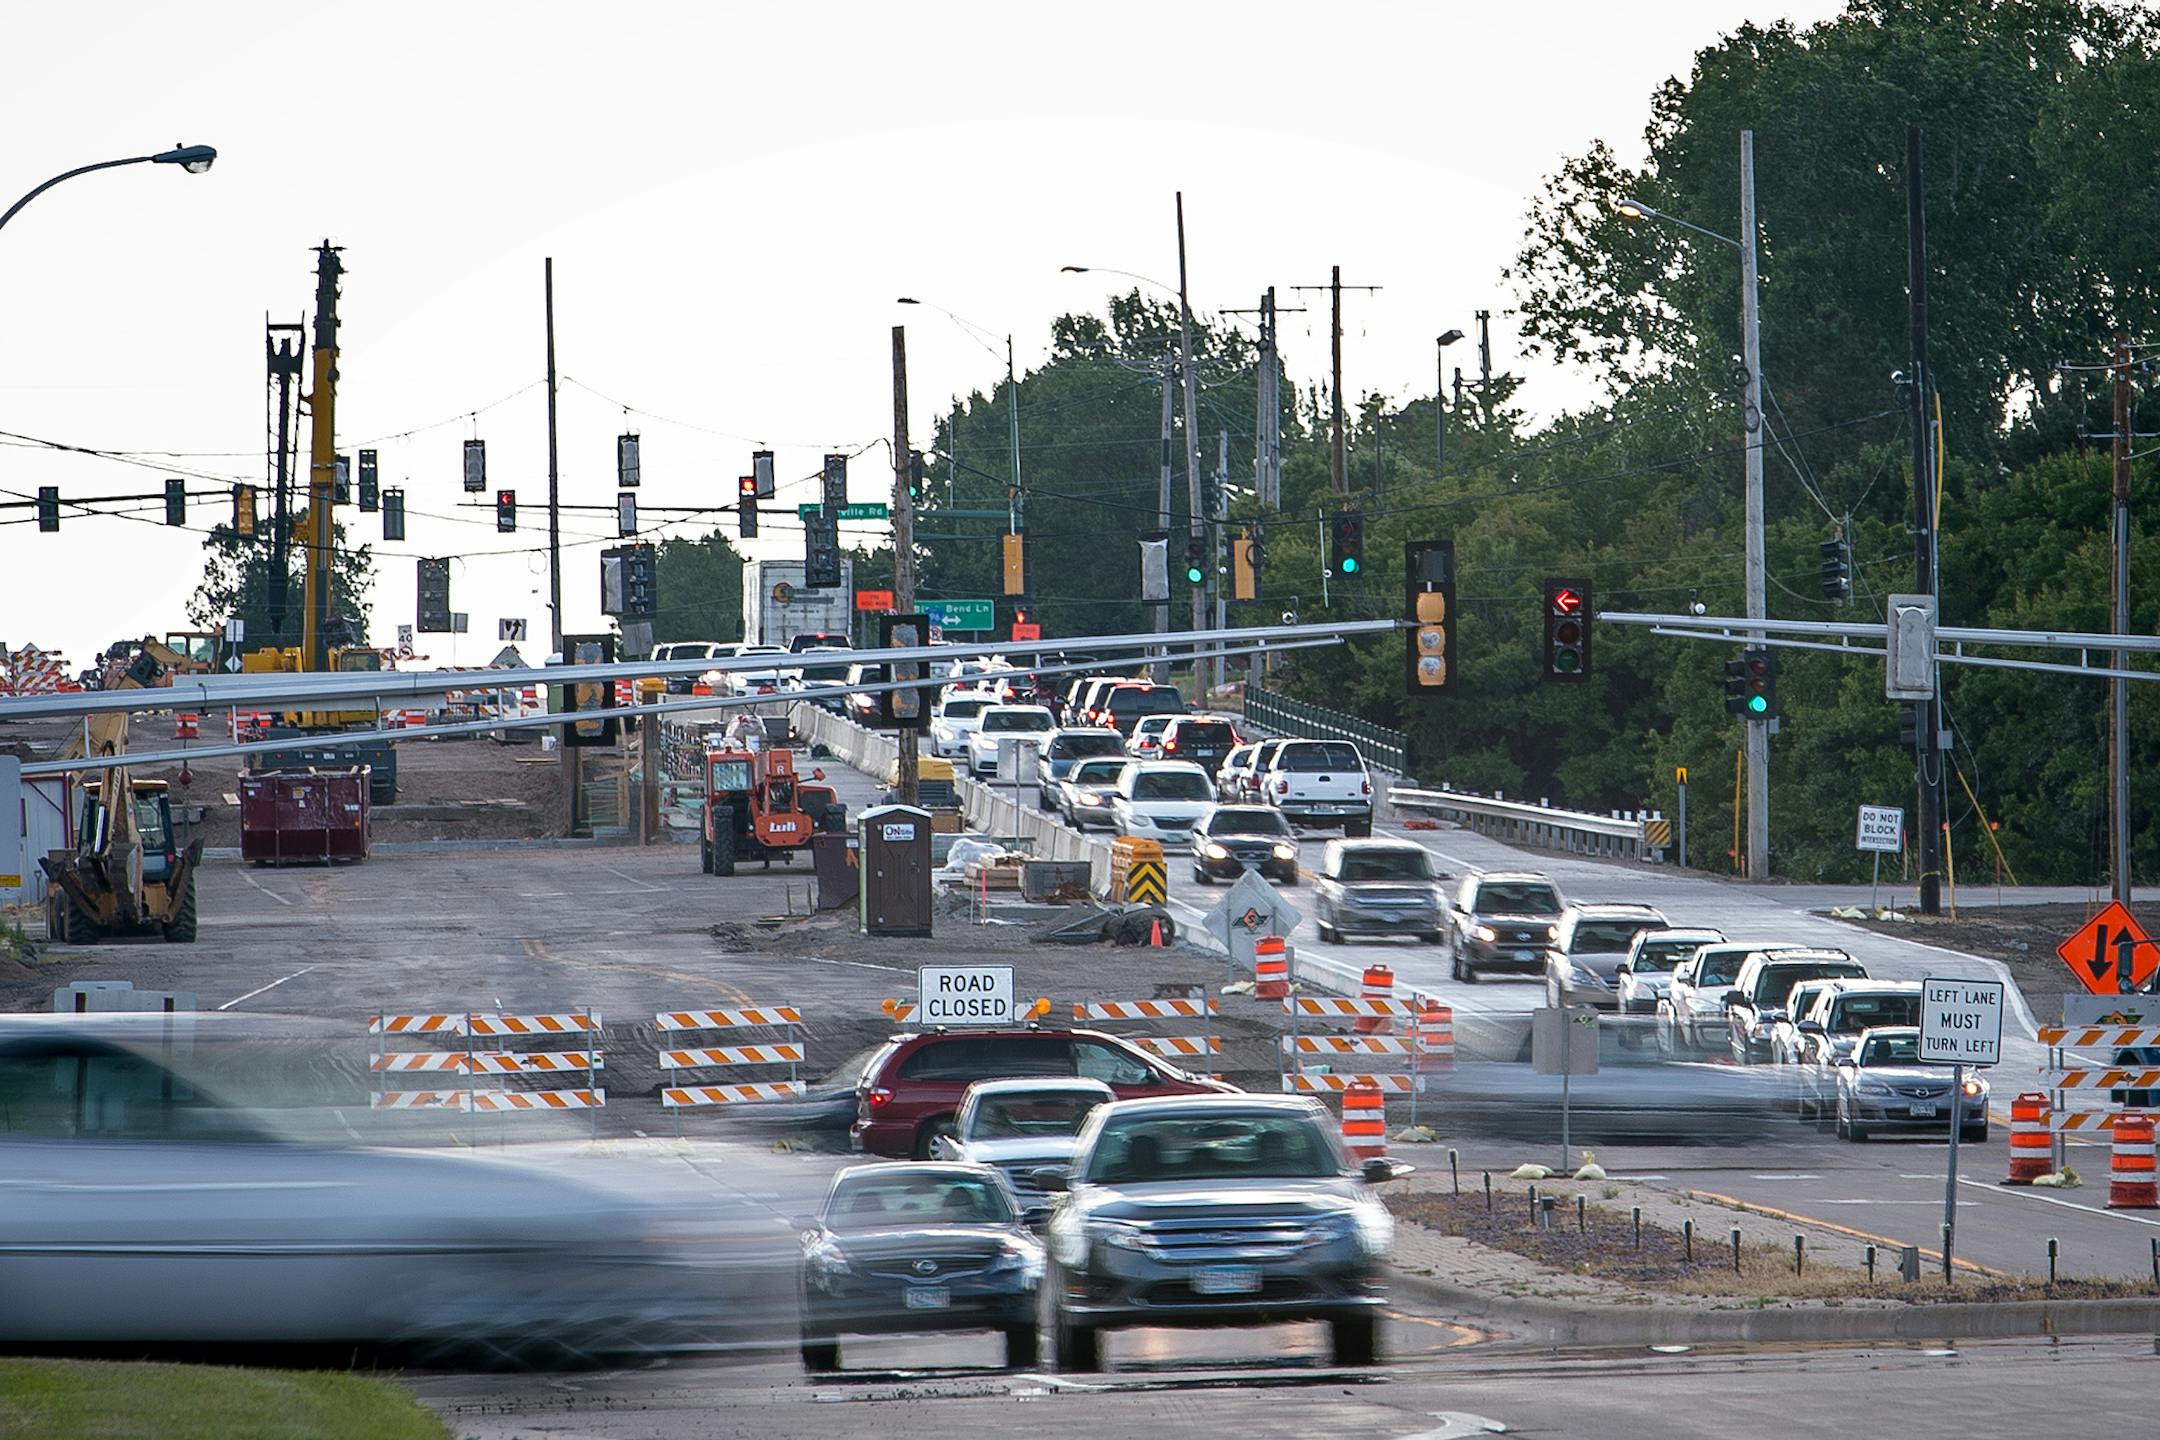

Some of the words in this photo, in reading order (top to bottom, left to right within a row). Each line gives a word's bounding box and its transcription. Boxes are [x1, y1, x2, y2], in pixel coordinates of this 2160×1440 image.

[868, 507, 883, 516] Rd
[946, 604, 972, 613] Bend
[976, 604, 989, 613] Ln
[399, 634, 412, 642] 40
[1863, 812, 1876, 821] DO
[1880, 813, 1899, 824] NOT
[1864, 824, 1896, 835] BLOCK
[940, 974, 995, 993] ROAD
[1930, 989, 1959, 1003] LEFT
[1965, 991, 1996, 1005] LANE
[929, 998, 1006, 1017] CLOSED
[1941, 1012, 1982, 1030] MUST
[1925, 1036, 1958, 1051] TURN
[1965, 1039, 1995, 1053] LEFT
